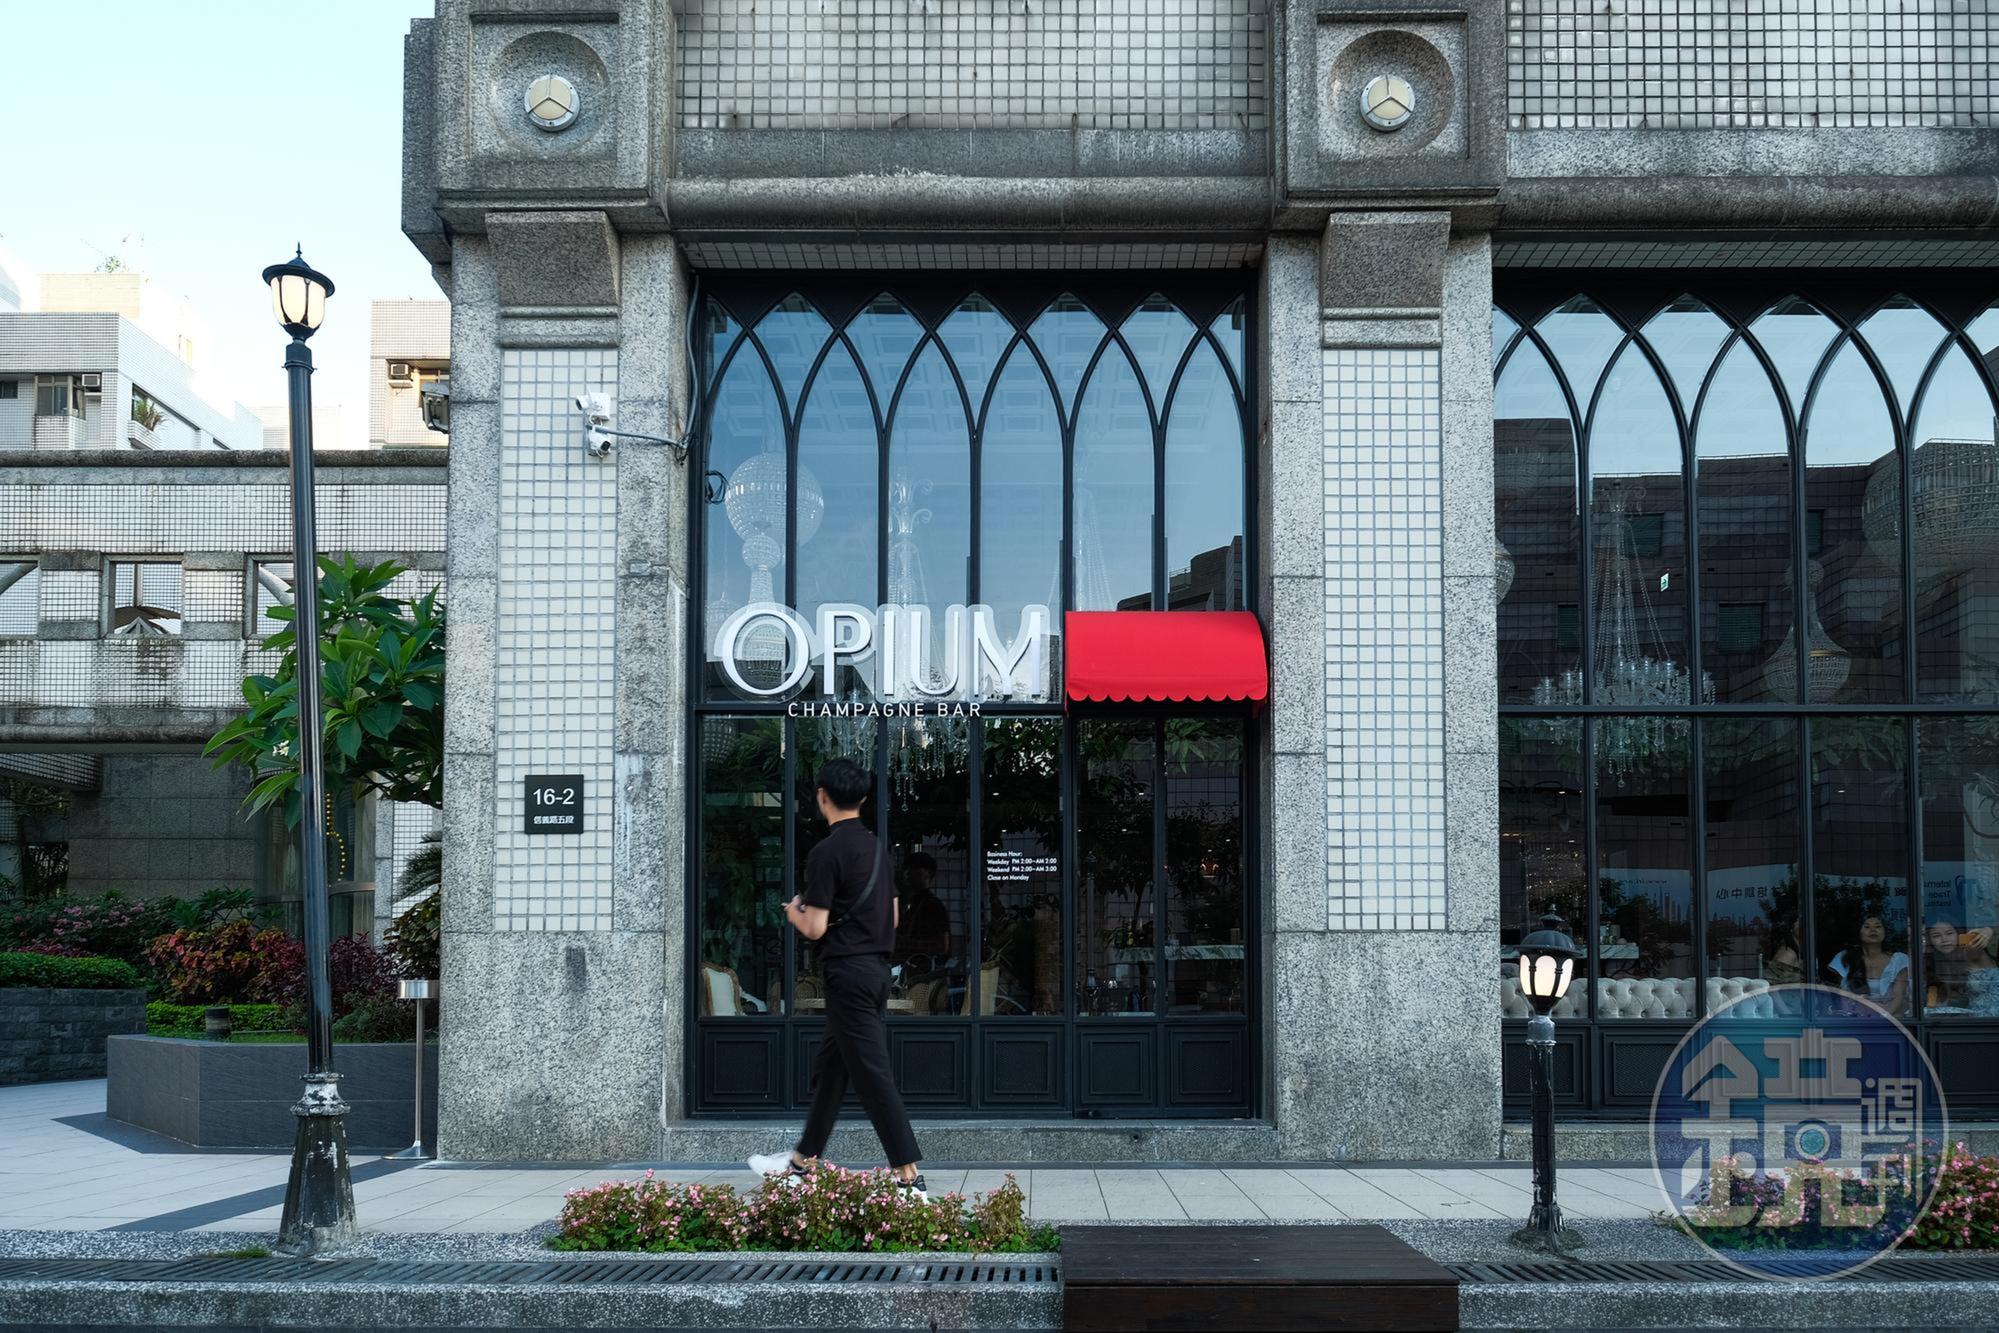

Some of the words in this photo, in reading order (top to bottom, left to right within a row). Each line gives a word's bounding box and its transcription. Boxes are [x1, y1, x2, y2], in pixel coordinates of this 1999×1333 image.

[722, 609, 1041, 698] OPIUM
[787, 702, 925, 717] CHAMPAGNE
[937, 702, 982, 717] BAR
[533, 788, 575, 805] 16-2
[1009, 874, 1029, 882] Monday
